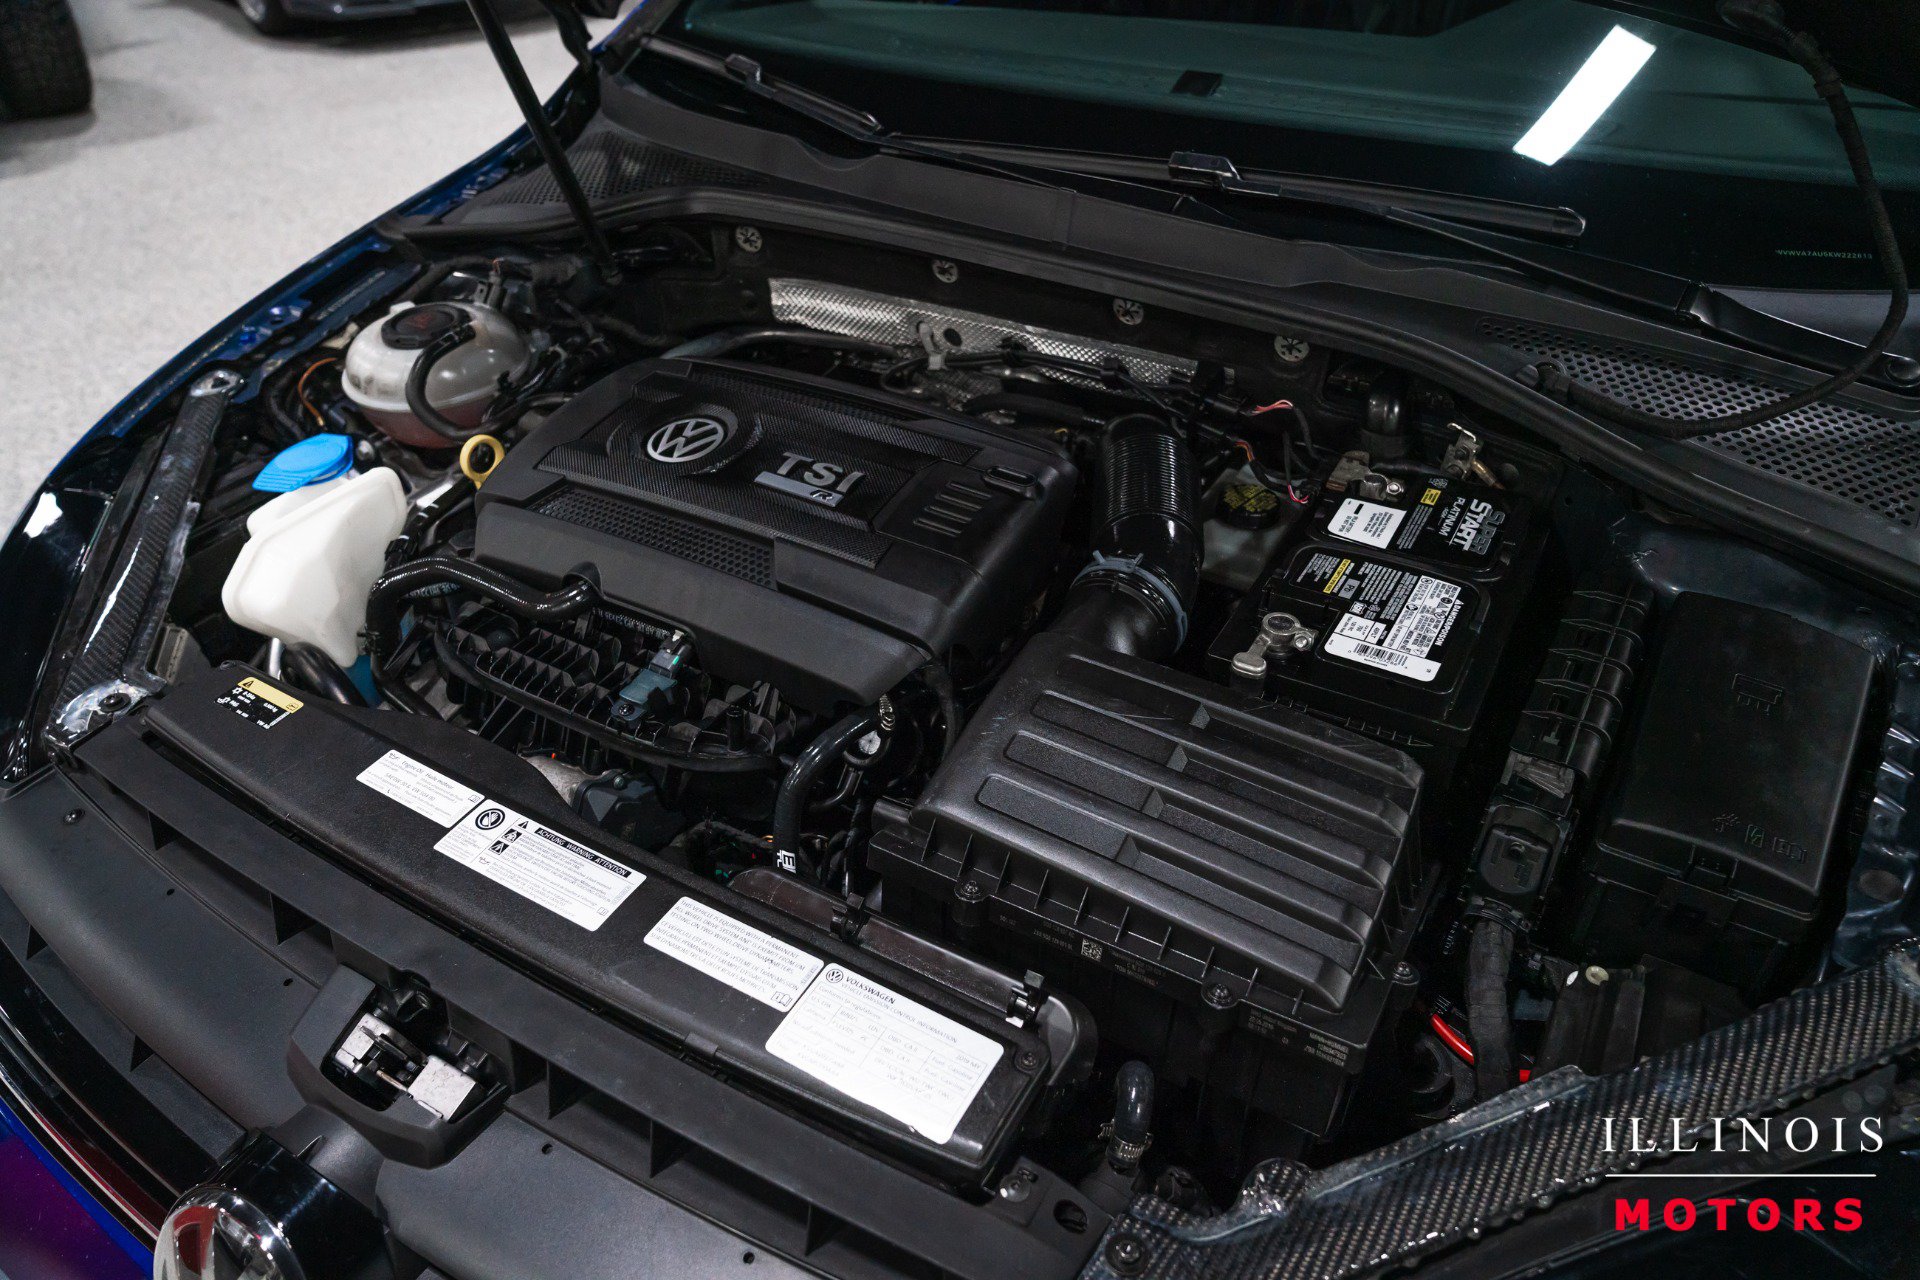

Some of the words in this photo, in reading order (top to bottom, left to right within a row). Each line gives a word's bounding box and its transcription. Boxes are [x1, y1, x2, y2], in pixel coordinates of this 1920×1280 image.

[776, 451, 866, 494] TSI
[1438, 496, 1466, 537] PLATINUM
[1455, 498, 1492, 551] START
[1474, 510, 1506, 556] SUPER
[1343, 583, 1354, 592] Pb
[536, 829, 565, 845] ACHTUNG
[565, 843, 594, 859] WARNING
[594, 857, 627, 875] ATTENTION
[669, 911, 692, 924] TESTING
[689, 921, 701, 929] ON
[699, 925, 714, 935] TWO
[712, 932, 733, 944] WHEEL
[731, 941, 749, 952] DRIVE
[680, 938, 712, 957] PERMANENT
[683, 909, 703, 921] WHEEL
[702, 918, 719, 929] DRIVE
[717, 926, 739, 939] SYSTEM
[756, 944, 779, 958] EXEMPT
[777, 955, 795, 966] FROM
[691, 905, 714, 918] VEHICLE
[717, 918, 746, 934] EQUIPPED
[744, 930, 761, 941] WITH
[764, 940, 799, 959] PERMANENT
[759, 968, 799, 991] TRANSMISSION
[844, 975, 896, 1005] VOLKSWAGEN
[862, 992, 890, 1009] EMISSION
[889, 1006, 918, 1023] CONTROL
[915, 1018, 958, 1043] INFORMATION
